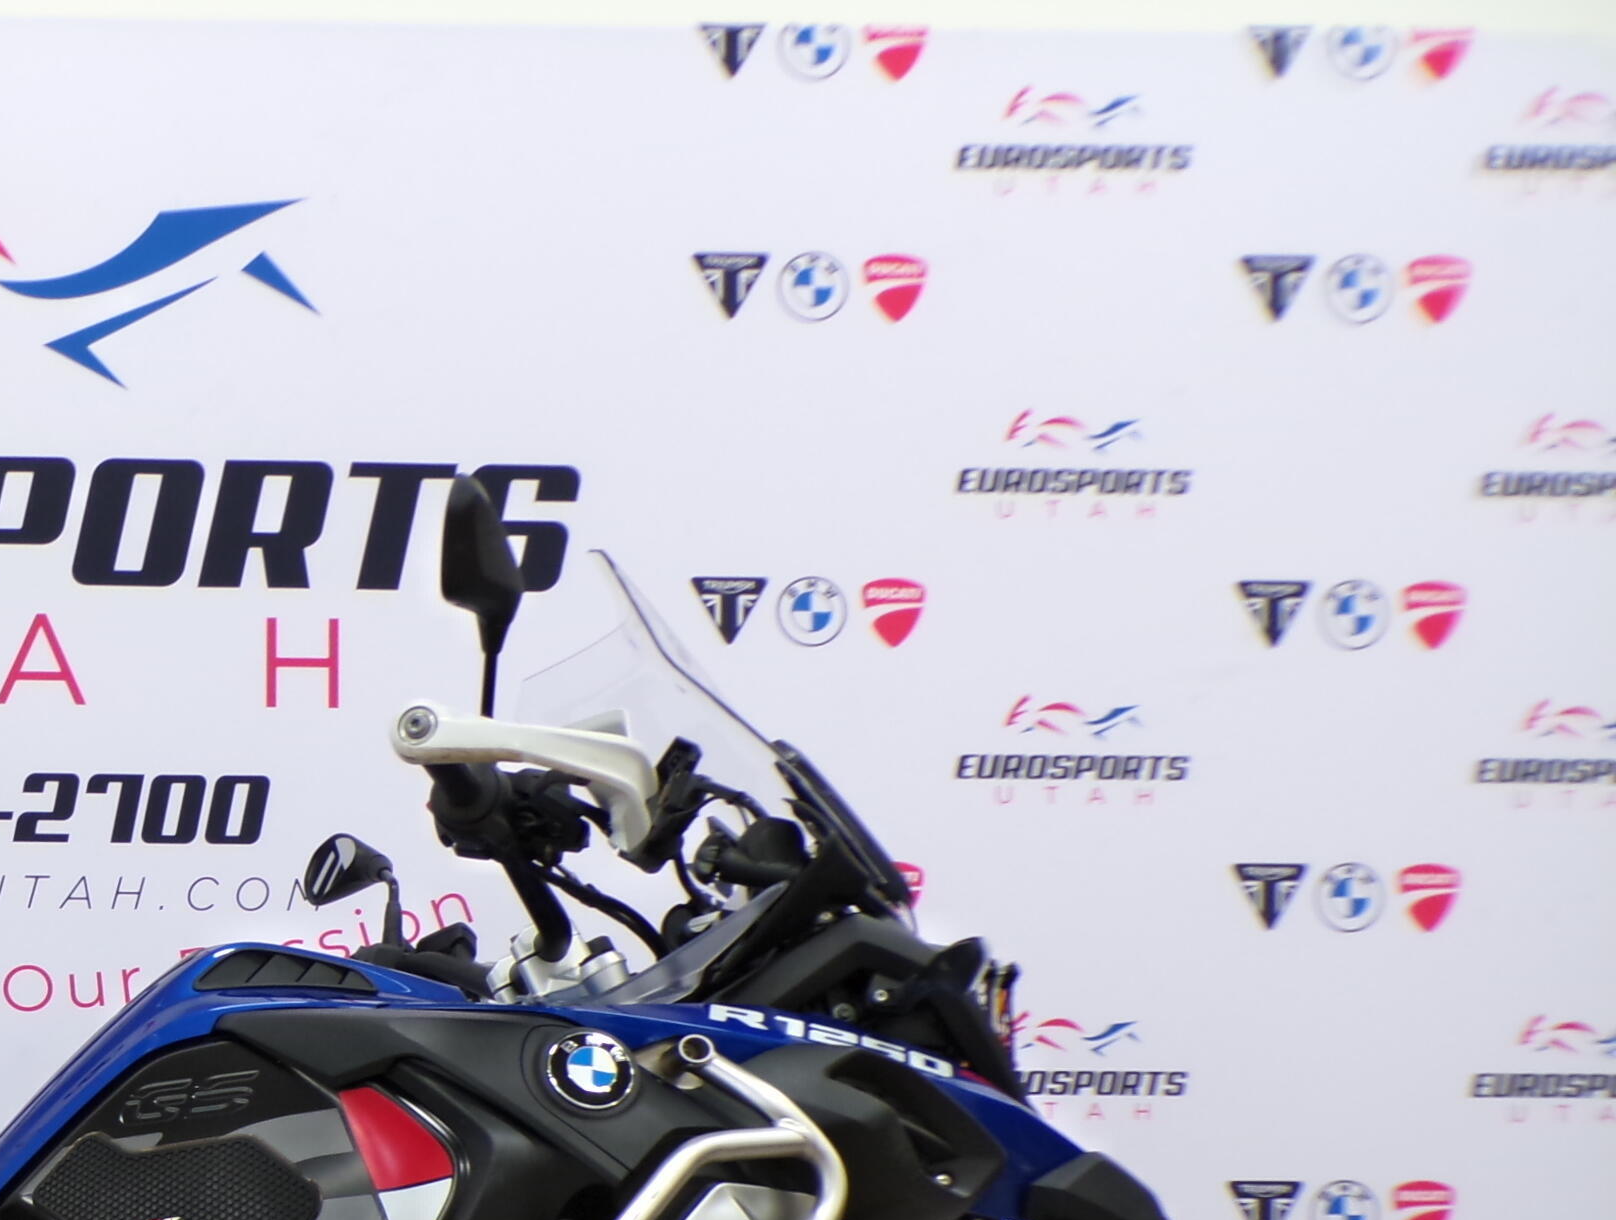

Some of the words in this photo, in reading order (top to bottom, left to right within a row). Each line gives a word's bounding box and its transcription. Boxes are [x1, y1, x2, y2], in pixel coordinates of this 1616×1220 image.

[956, 145, 1192, 171] EUROSPORTS
[955, 468, 1193, 496] EUROSPORTS
[955, 755, 1190, 782] EUROSPORTS
[1478, 758, 1616, 783] EUROSP
[2, 964, 142, 1013] Our
[708, 1003, 768, 1030] R
[773, 1015, 954, 1078] 1250
[1021, 1070, 1188, 1096] OSPORTS
[1044, 1102, 1152, 1120] TAH
